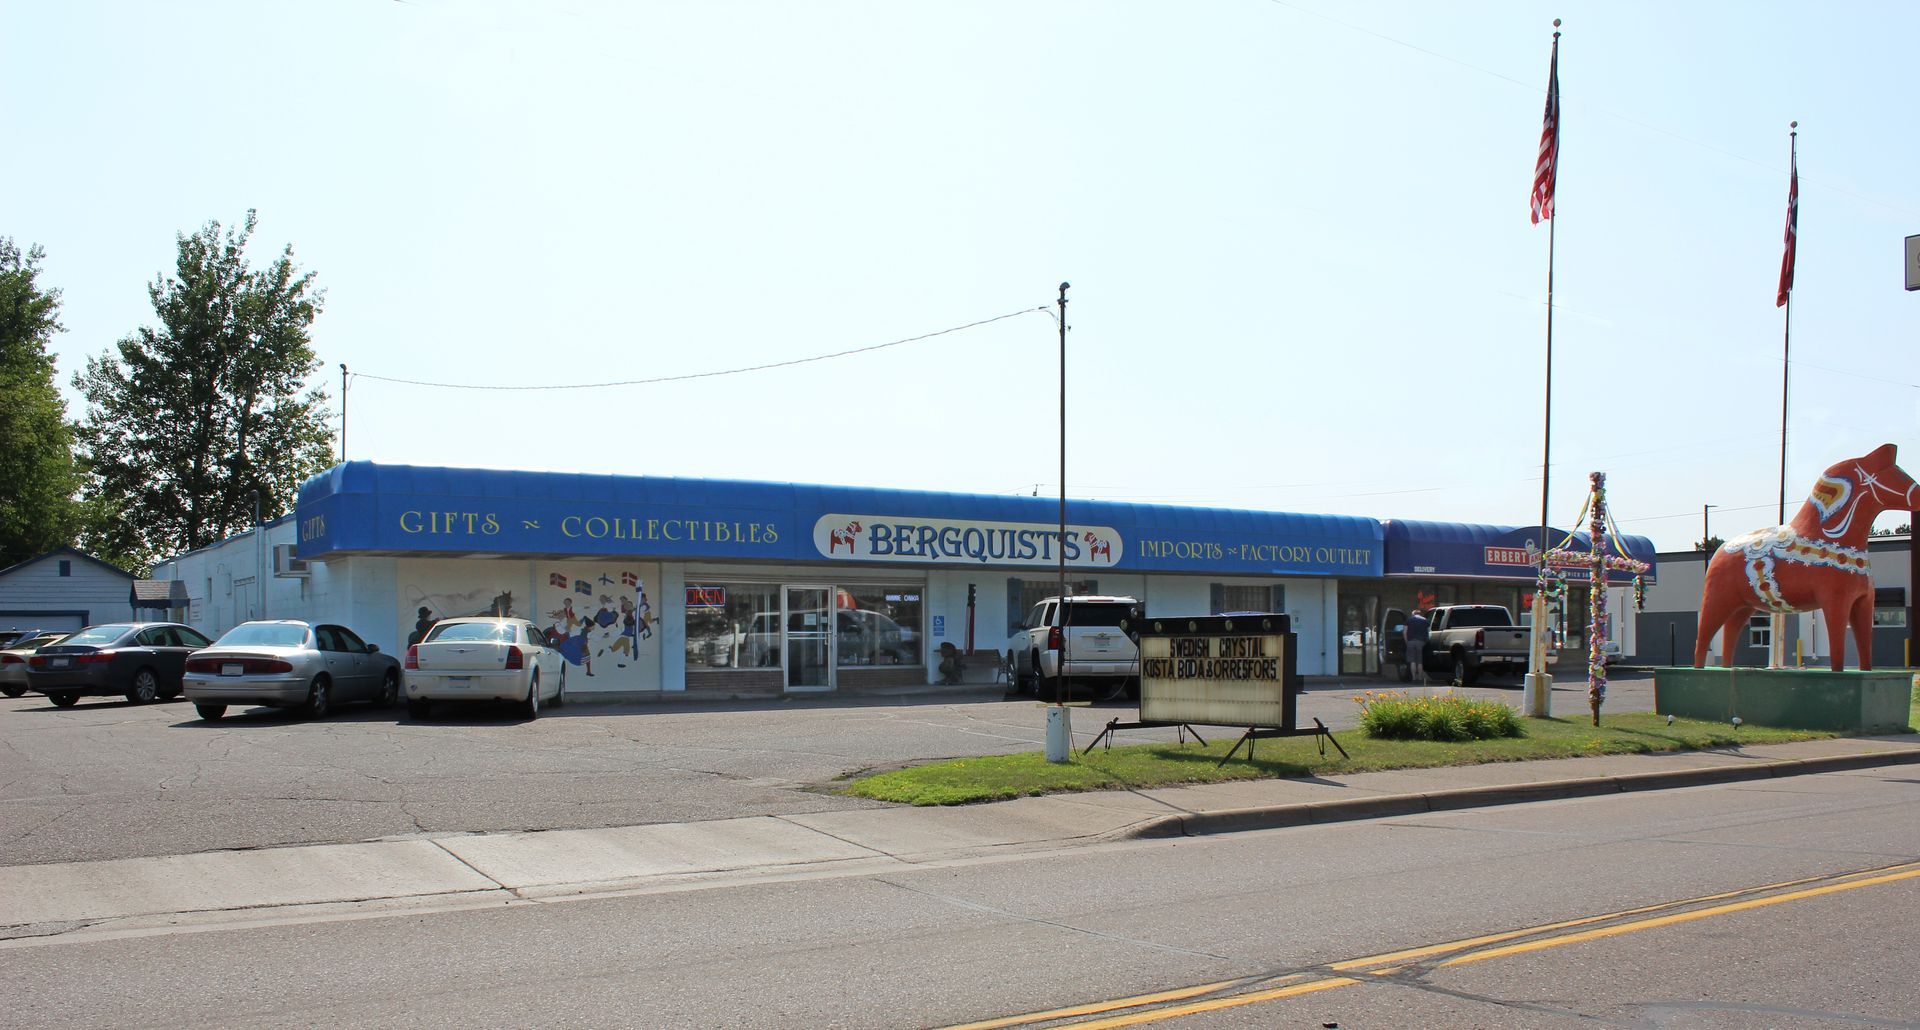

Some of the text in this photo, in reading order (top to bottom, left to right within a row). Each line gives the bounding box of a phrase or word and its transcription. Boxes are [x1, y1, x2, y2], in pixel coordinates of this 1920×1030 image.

[302, 514, 325, 541] GIFTS
[400, 511, 500, 535] GIFTS
[561, 515, 779, 545] COLLECTIBLES
[1140, 540, 1222, 560] IMPORTS
[1241, 544, 1312, 563] FACTORY
[1316, 547, 1370, 565] OUTLET
[1487, 549, 1527, 563] ERBERT
[686, 589, 724, 605] OPEN
[1170, 637, 1265, 658] SWEDISH CRYSTAL
[1142, 659, 1175, 678] KOSTA
